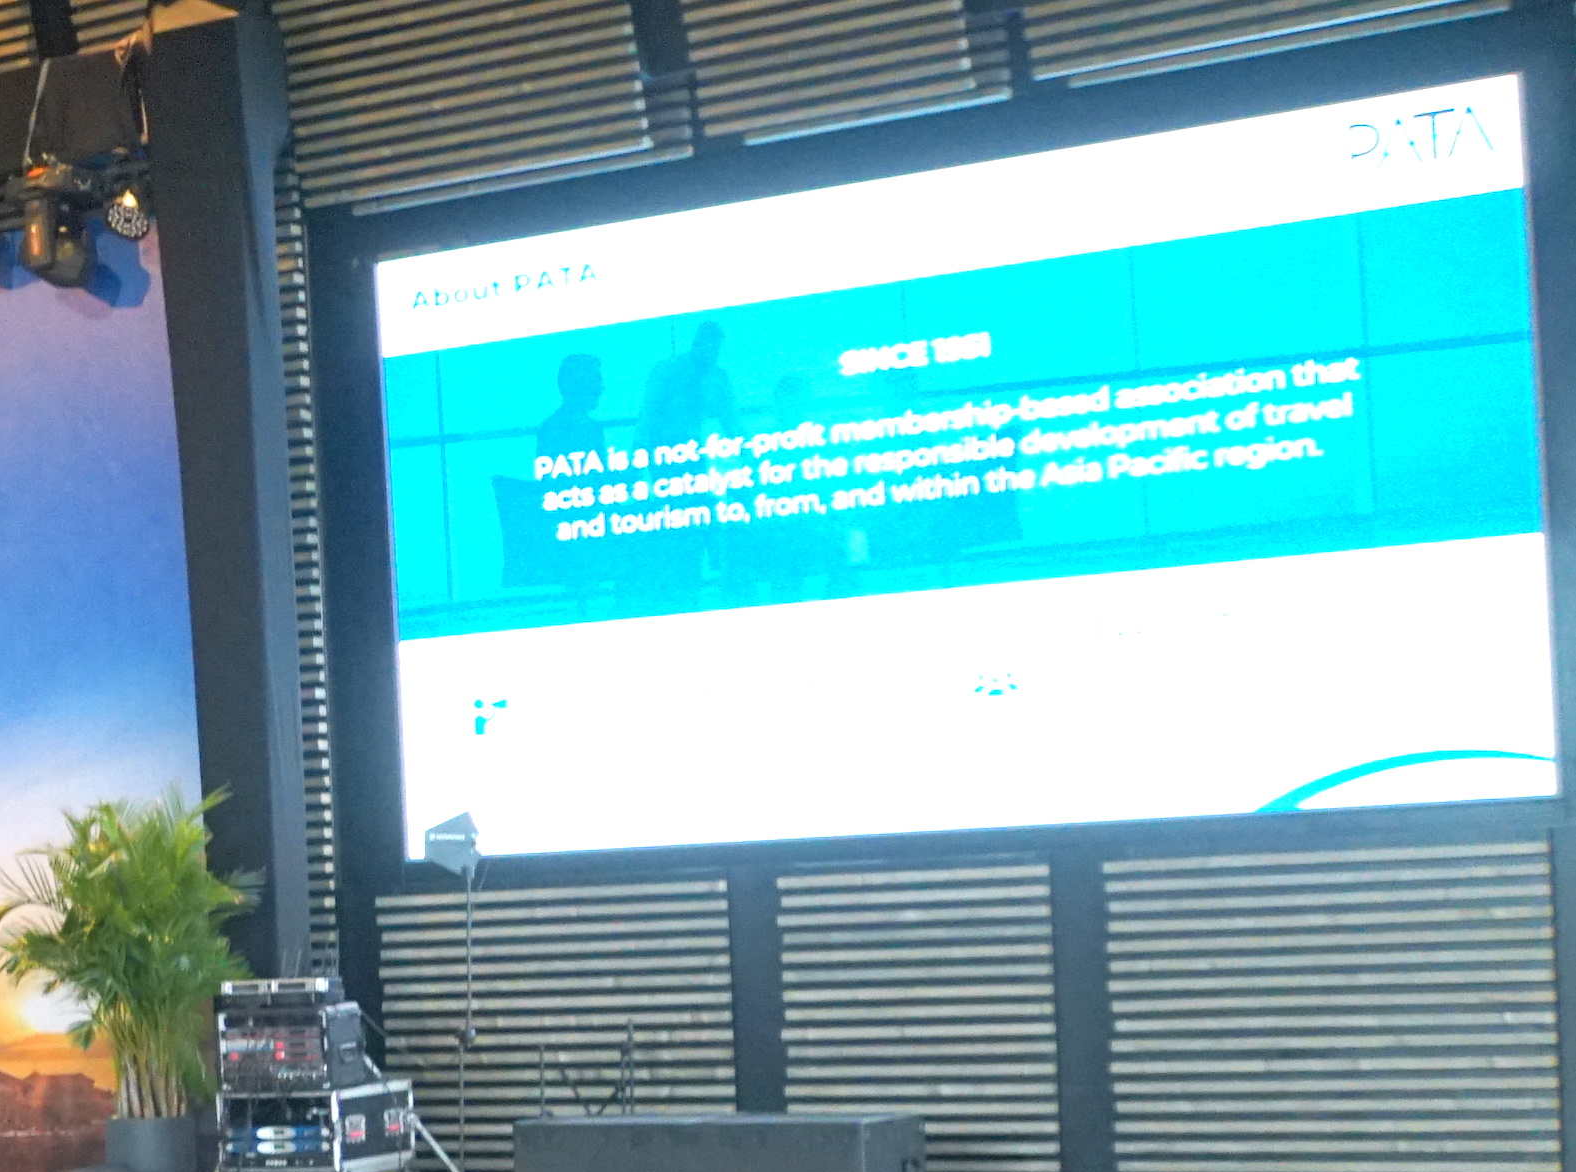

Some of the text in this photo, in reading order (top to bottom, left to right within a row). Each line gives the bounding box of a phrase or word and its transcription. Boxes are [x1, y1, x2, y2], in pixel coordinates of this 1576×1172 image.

[1349, 106, 1493, 167] PATA
[413, 264, 596, 309] About PATA
[839, 340, 929, 376] SINCE
[534, 356, 1360, 482] PATA is a not-for-profit membership-based association that
[542, 391, 1354, 512] acts as a catalyst for the responsible development of travel
[555, 436, 1324, 542] and tourism to, from, and within the Asia Pacific region.
